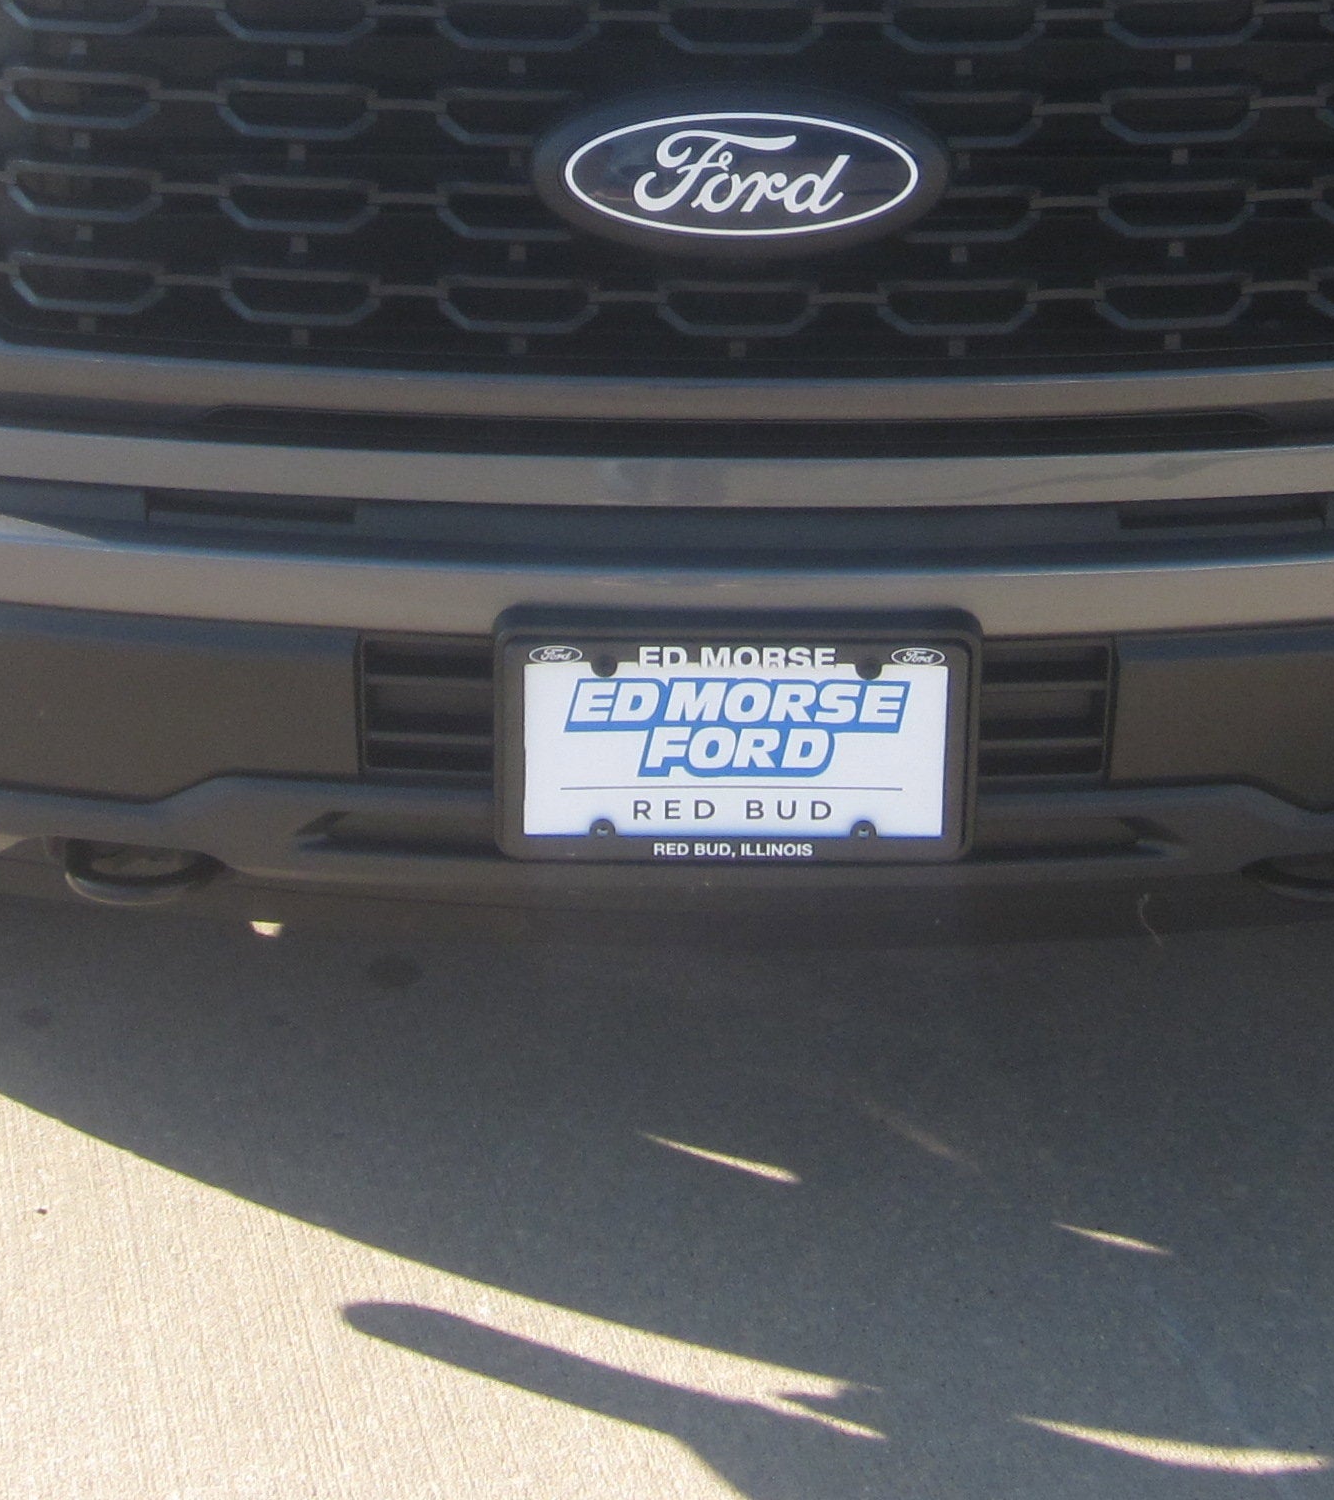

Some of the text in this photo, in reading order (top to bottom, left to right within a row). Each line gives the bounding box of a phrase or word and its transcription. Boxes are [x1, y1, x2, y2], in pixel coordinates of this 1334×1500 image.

[633, 130, 851, 214] Ford
[638, 646, 836, 668] ED MORSE
[568, 680, 907, 725] ED MORSE
[644, 727, 832, 770] FORD
[633, 800, 832, 820] RED BUD
[653, 843, 813, 858] RED BUD, ILLINOIS
